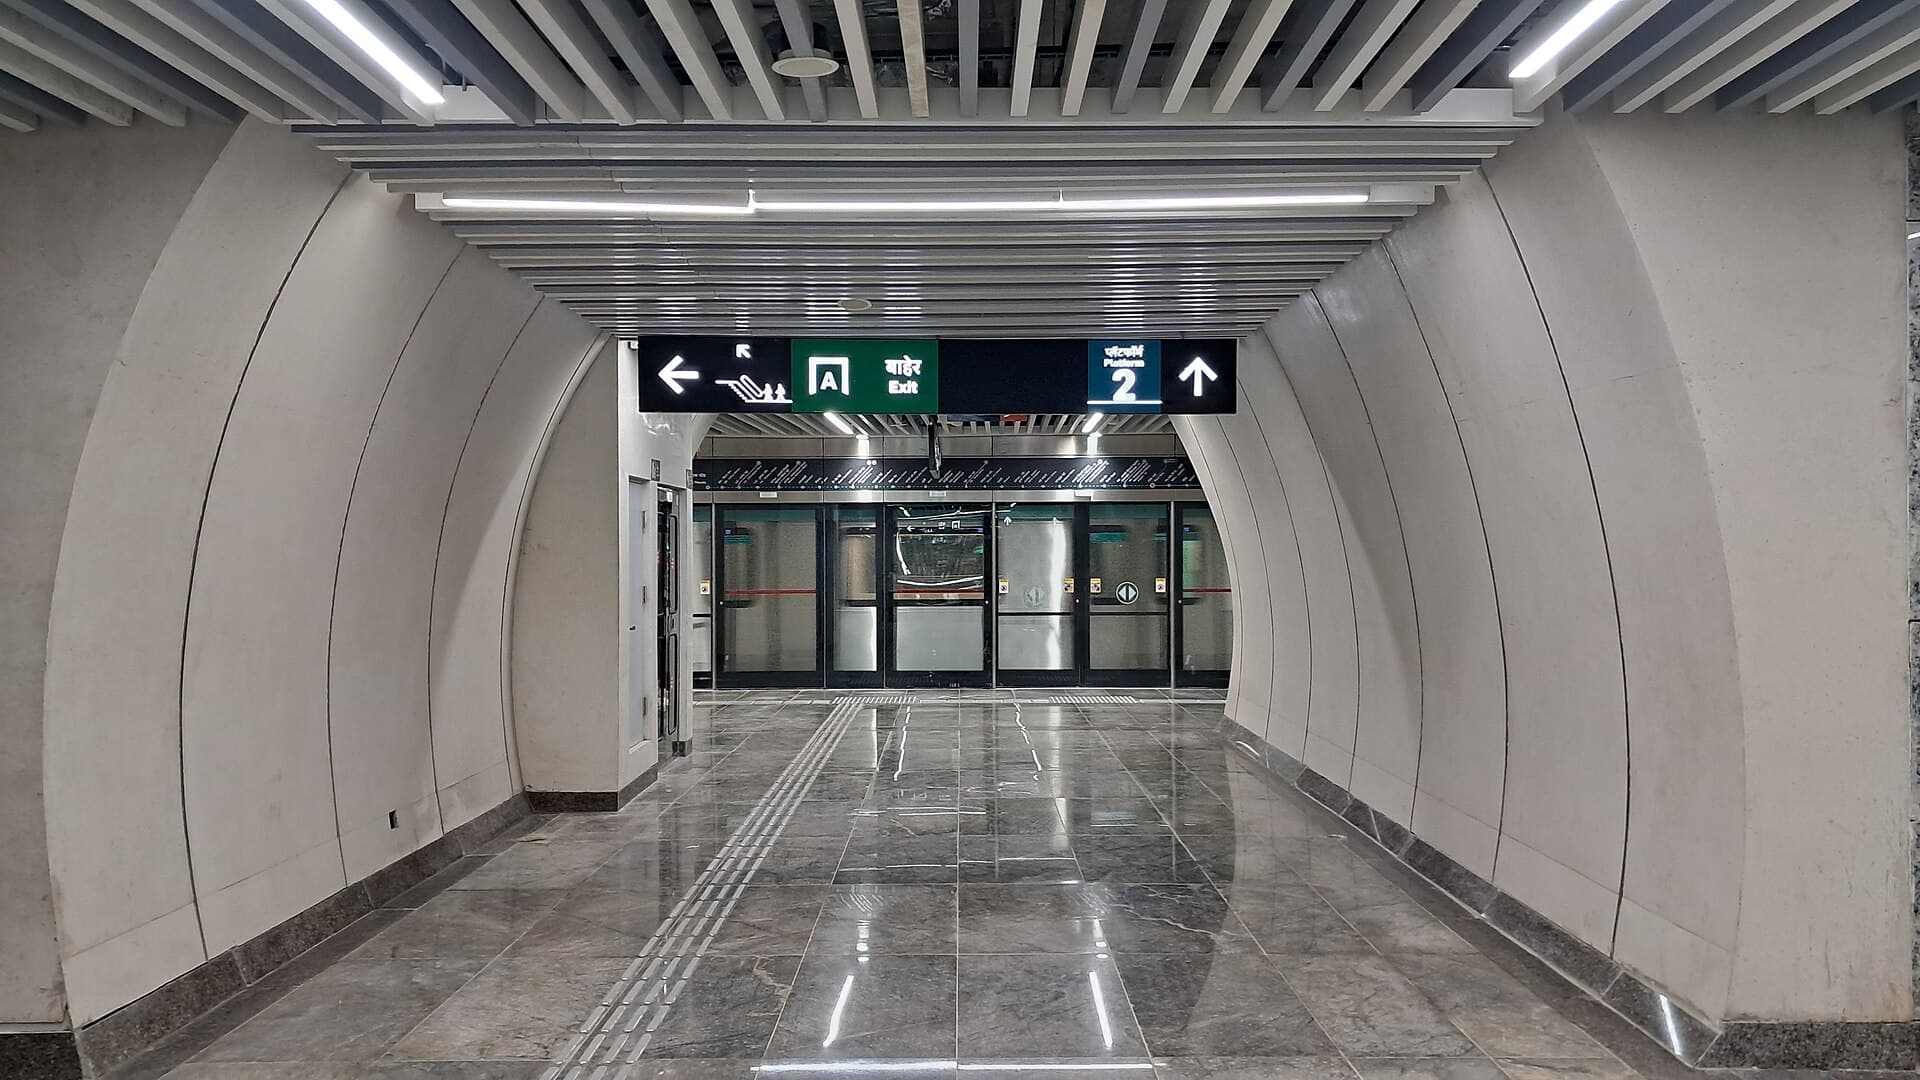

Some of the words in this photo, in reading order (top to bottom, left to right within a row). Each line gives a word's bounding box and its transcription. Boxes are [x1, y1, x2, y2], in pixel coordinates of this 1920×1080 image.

[884, 355, 922, 377] बाहेर
[1103, 358, 1145, 367] Platform
[820, 371, 838, 390] A
[888, 380, 918, 394] Exit
[1112, 368, 1136, 401] 2
